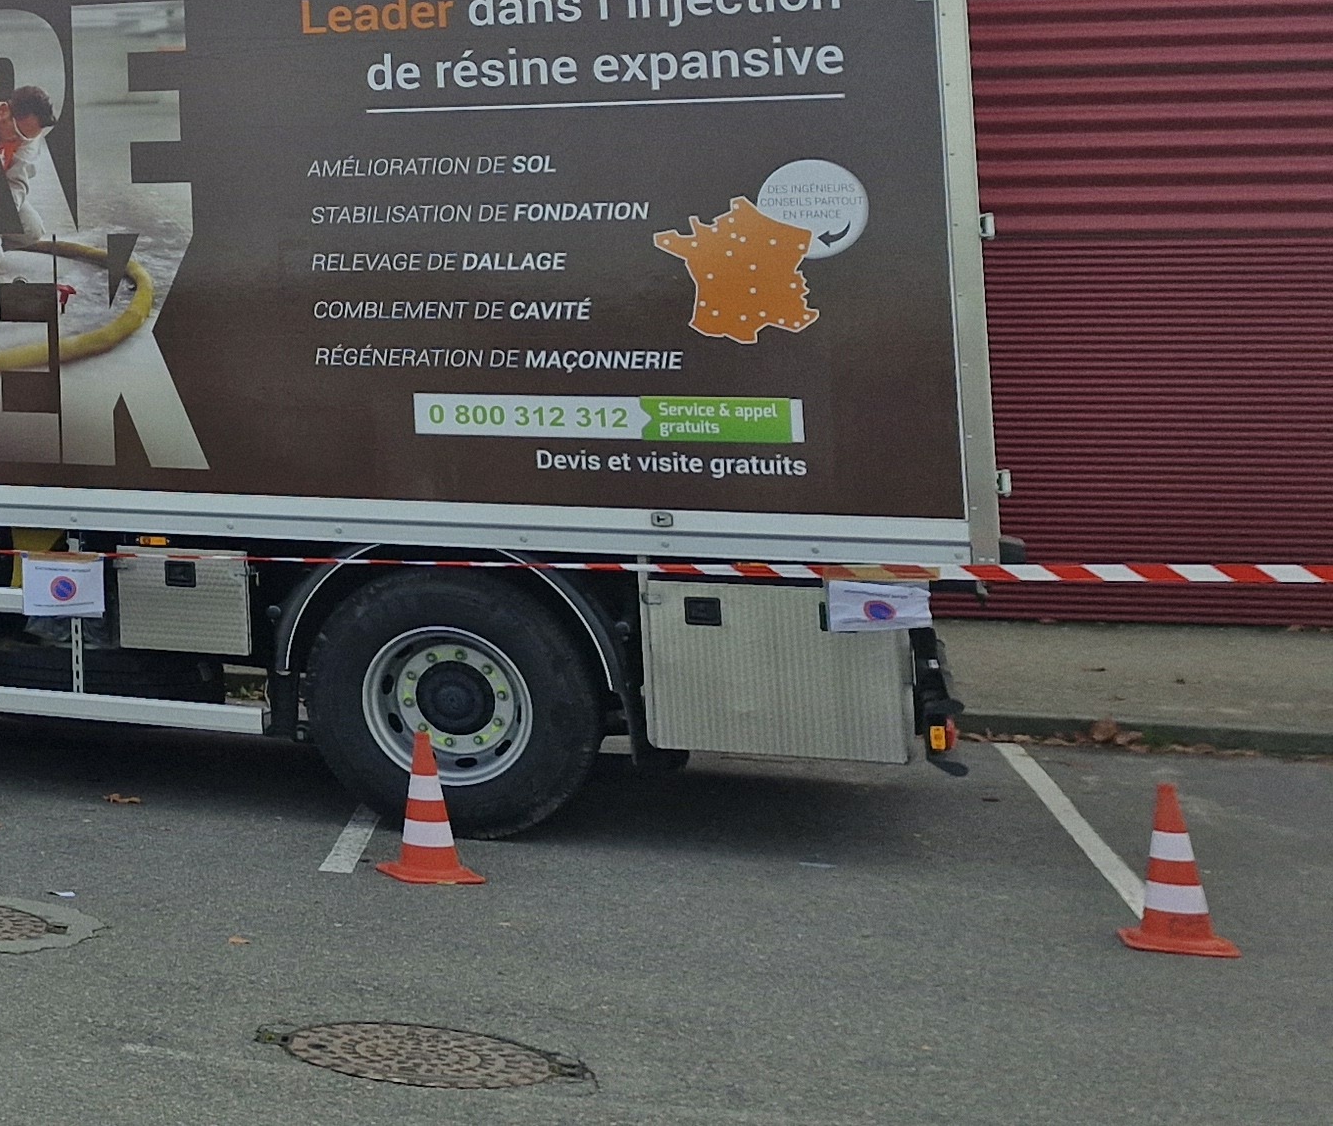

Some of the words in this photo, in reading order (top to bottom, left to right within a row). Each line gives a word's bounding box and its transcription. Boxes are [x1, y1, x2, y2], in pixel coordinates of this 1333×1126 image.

[367, 52, 421, 91] de
[436, 47, 578, 88] résine
[593, 36, 844, 91] expansive
[307, 155, 471, 177] AMÉLIORATION
[477, 156, 507, 175] DE
[511, 155, 557, 174] SOL
[767, 184, 788, 194] DES
[791, 182, 856, 193] INGÉNIEURS
[311, 204, 472, 224] STABILISATION
[478, 203, 509, 222] DE
[513, 201, 649, 221] FONDATION
[760, 197, 813, 207] CONSEILS
[814, 196, 864, 206] PARTOUT
[782, 210, 797, 220] EN
[799, 209, 842, 219] FRANCE
[311, 252, 422, 272] RELEVAGE
[427, 252, 458, 271] DE
[462, 252, 568, 271] DALLAGE
[313, 301, 469, 320] COMBLEMENT
[474, 301, 505, 320] DE
[509, 297, 593, 320] CAVITÉ
[489, 349, 520, 368] DE
[524, 350, 684, 373] MAÇONNERIE
[428, 404, 445, 425] 0
[454, 404, 505, 426] 800
[514, 405, 565, 427] 312
[576, 407, 629, 428] 312
[658, 401, 716, 418] Service
[719, 403, 731, 418] &
[734, 403, 778, 421] appel
[659, 419, 720, 437] gratuits
[536, 449, 601, 471] Devis
[608, 451, 631, 472] et
[638, 451, 703, 474] visite
[710, 454, 807, 479] gratuits
